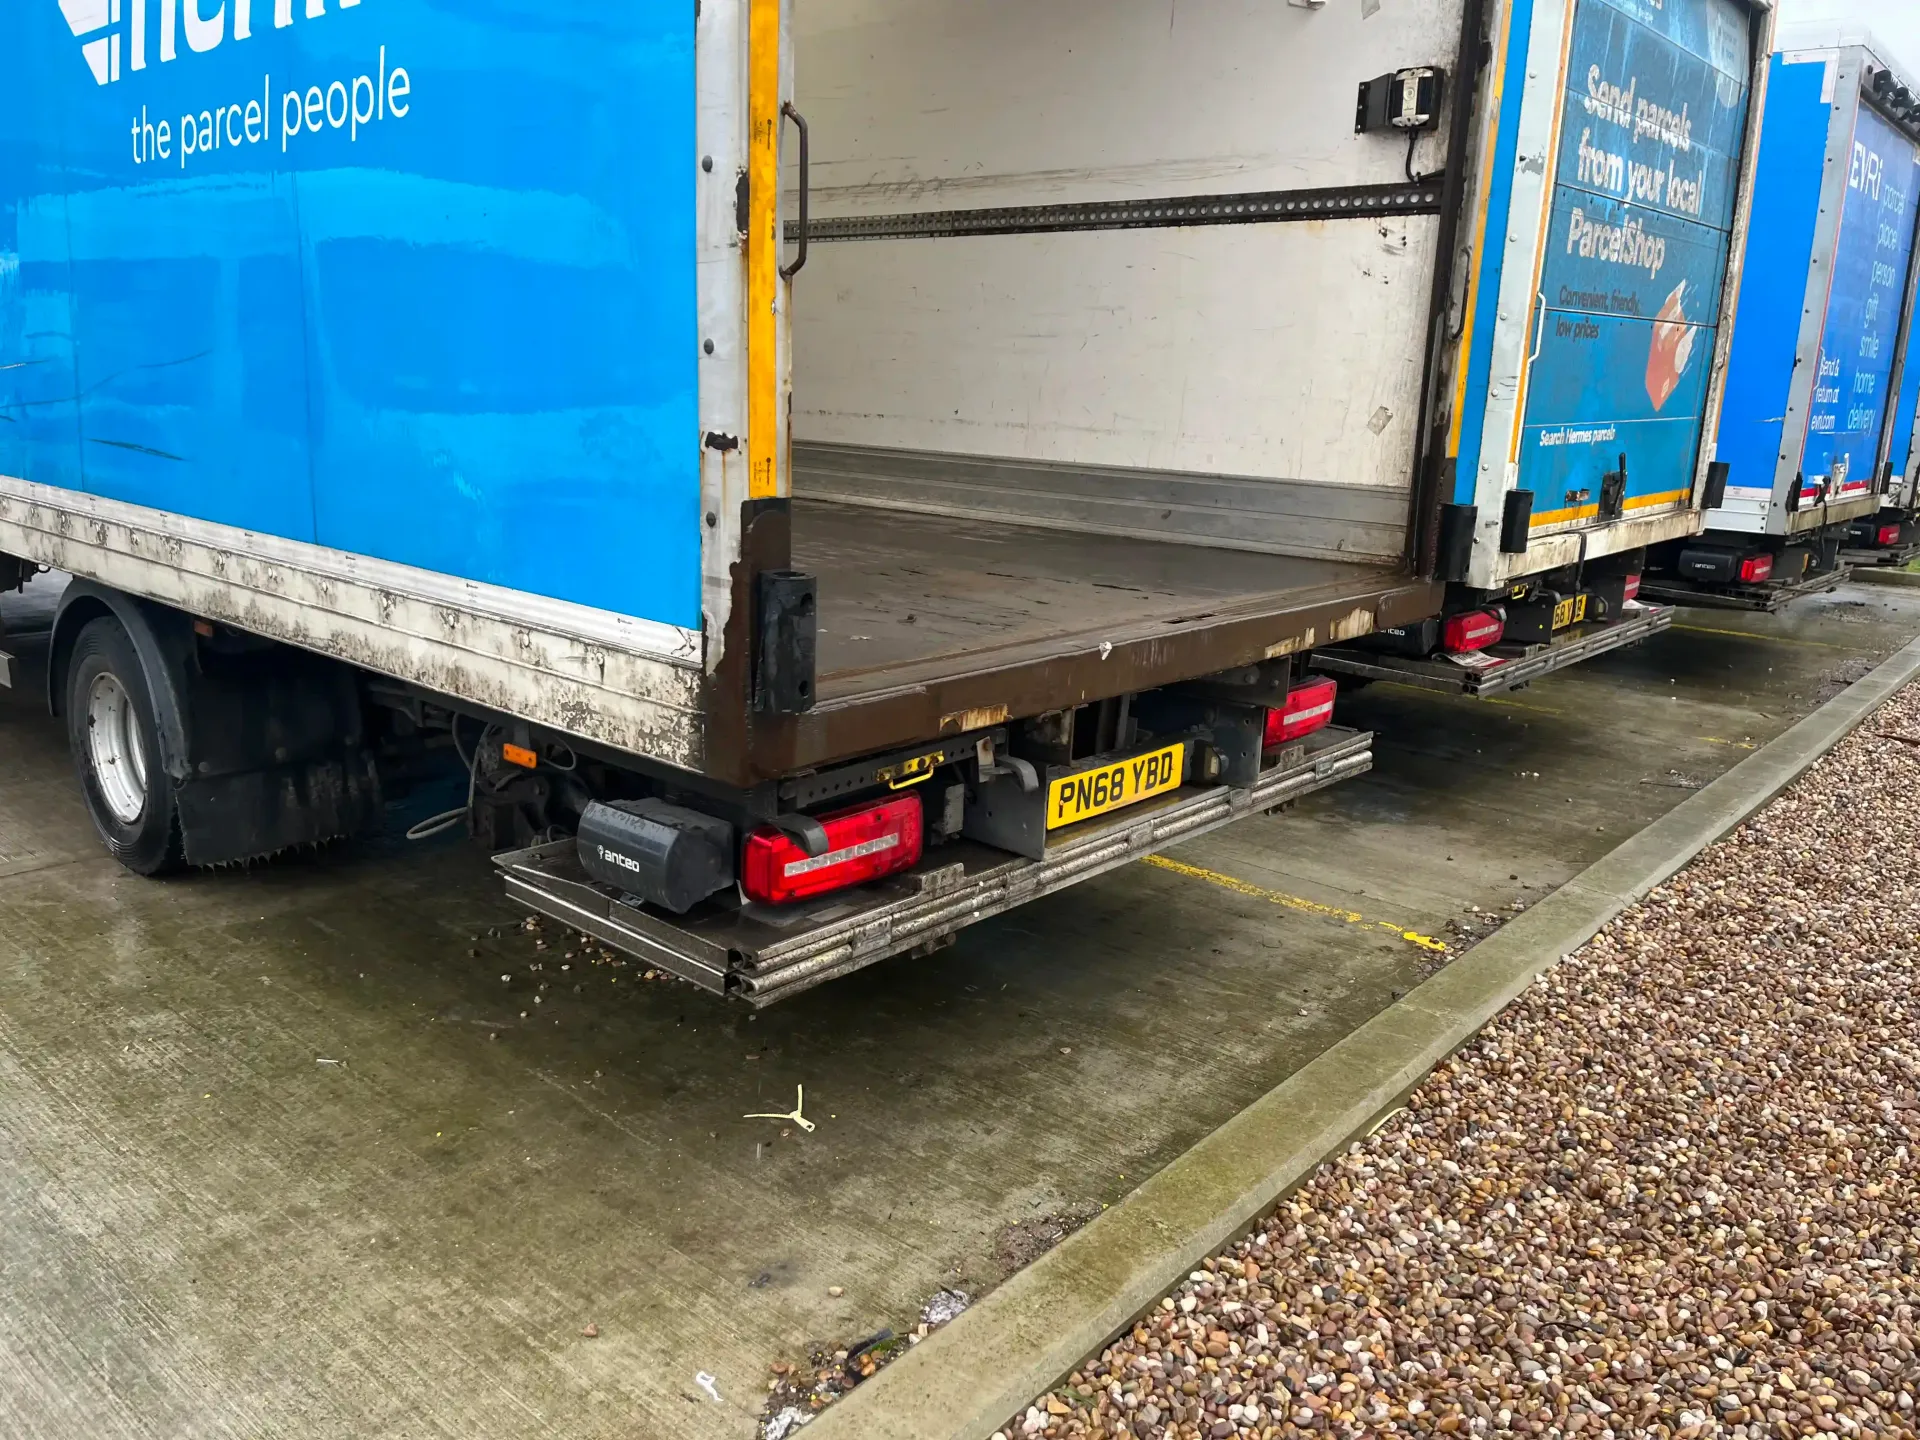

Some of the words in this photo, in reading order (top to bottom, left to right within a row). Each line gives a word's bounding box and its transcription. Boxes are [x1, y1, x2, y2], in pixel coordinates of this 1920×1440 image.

[131, 104, 172, 164] the
[181, 73, 270, 169] parcel
[282, 45, 411, 153] people
[1584, 64, 1636, 128] Send
[1633, 102, 1692, 152] parcels
[1577, 127, 1624, 192] from
[1623, 160, 1666, 209] your
[1665, 159, 1703, 215] local
[1881, 183, 1907, 216] parcel
[1566, 207, 1666, 279] ParcelShop
[1876, 222, 1898, 252] place
[1869, 259, 1896, 291] person
[1864, 292, 1880, 329] gift
[1555, 314, 1575, 337] low
[1573, 317, 1600, 342] prices
[1859, 331, 1880, 360] smile
[1815, 384, 1833, 403] return
[1853, 366, 1876, 395] home
[1539, 426, 1565, 447] Search
[1565, 427, 1593, 445] Hermes
[1591, 423, 1616, 446] parcels
[1847, 406, 1876, 438] delivery
[1058, 767, 1125, 819] PN68
[1132, 751, 1173, 794] YBD
[604, 849, 640, 873] anteo
